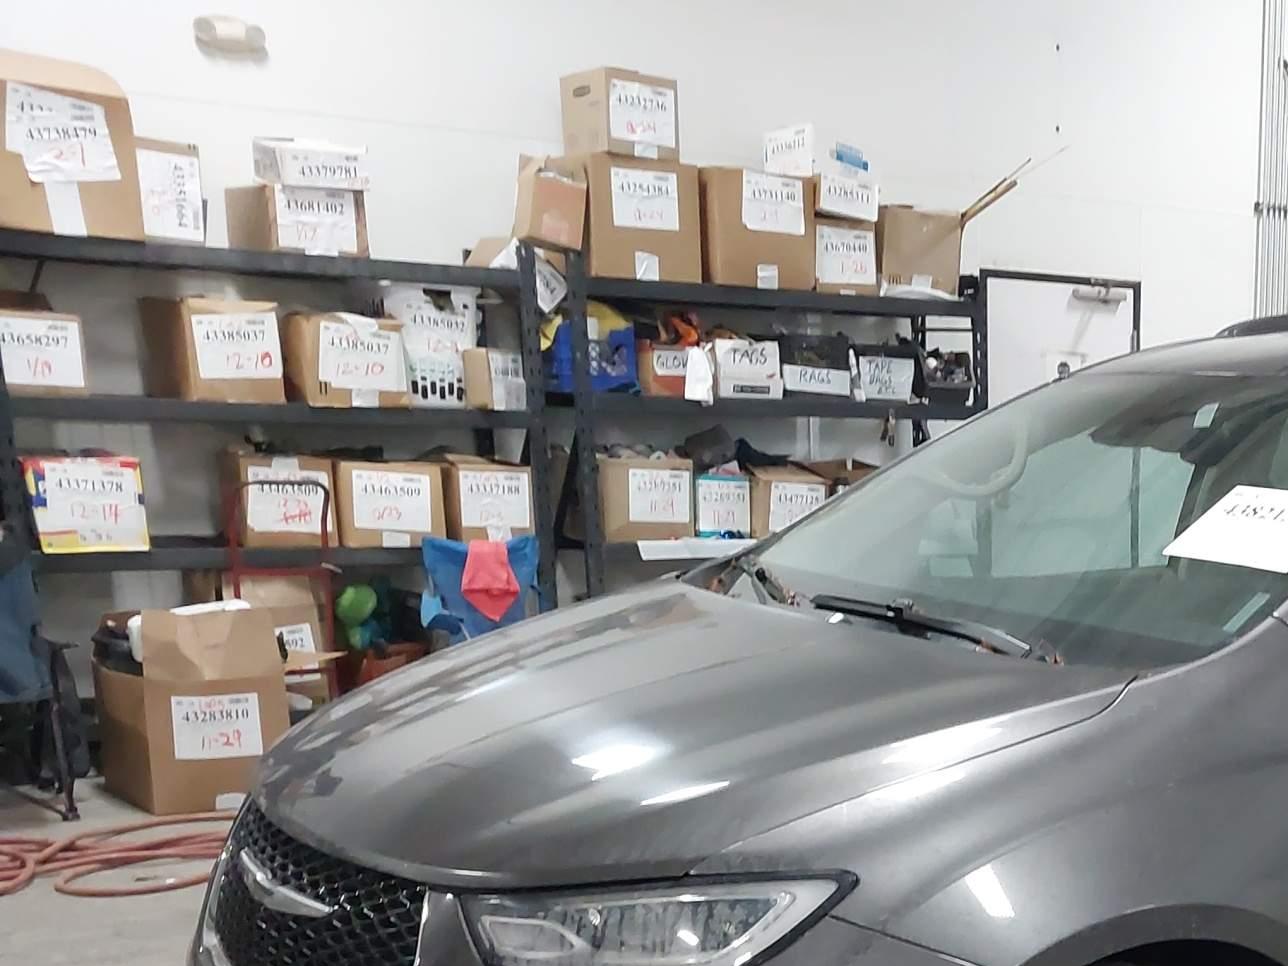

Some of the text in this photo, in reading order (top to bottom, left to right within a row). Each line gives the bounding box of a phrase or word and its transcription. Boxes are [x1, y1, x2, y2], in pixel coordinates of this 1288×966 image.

[25, 126, 97, 142] 43738479
[300, 164, 359, 179] 43379781
[284, 199, 345, 216] 43681402
[0, 332, 68, 348] 43658297
[203, 329, 265, 343] 43385037
[731, 347, 768, 366] TAGS
[866, 359, 893, 374] TAPE
[799, 368, 832, 385] RAGS
[869, 374, 892, 387] BAGS
[55, 477, 124, 493] 43371378
[361, 483, 421, 497] 43463509
[182, 708, 249, 724] 43283810
